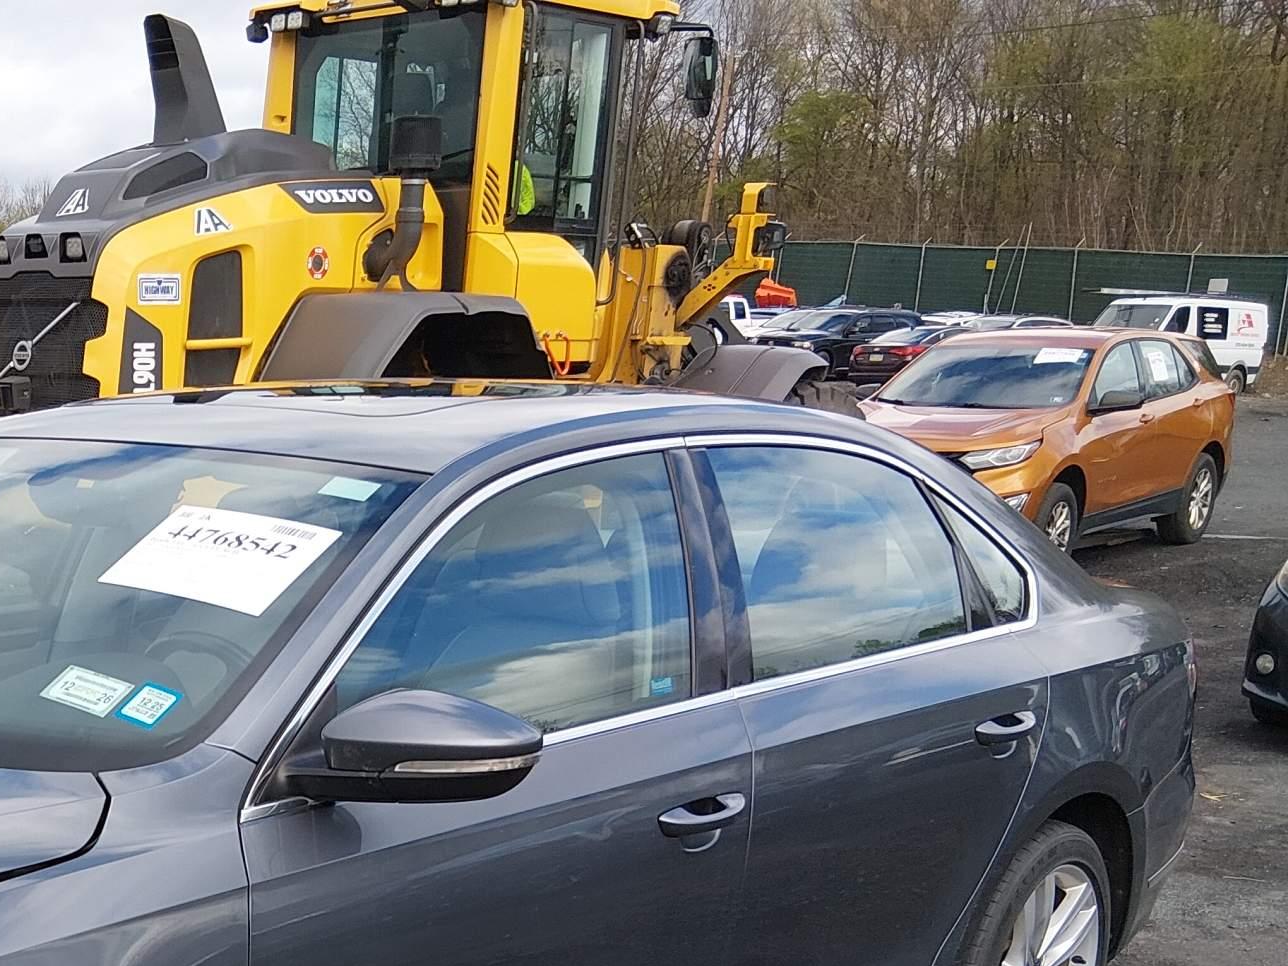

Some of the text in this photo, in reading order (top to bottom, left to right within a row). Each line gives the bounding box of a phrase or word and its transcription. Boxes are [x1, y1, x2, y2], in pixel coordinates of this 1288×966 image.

[294, 188, 374, 204] VOLVO
[144, 285, 175, 295] HIGHWAY
[133, 342, 155, 393] L90H
[167, 525, 298, 560] 44768542
[59, 680, 76, 691] 12
[96, 692, 114, 704] 26
